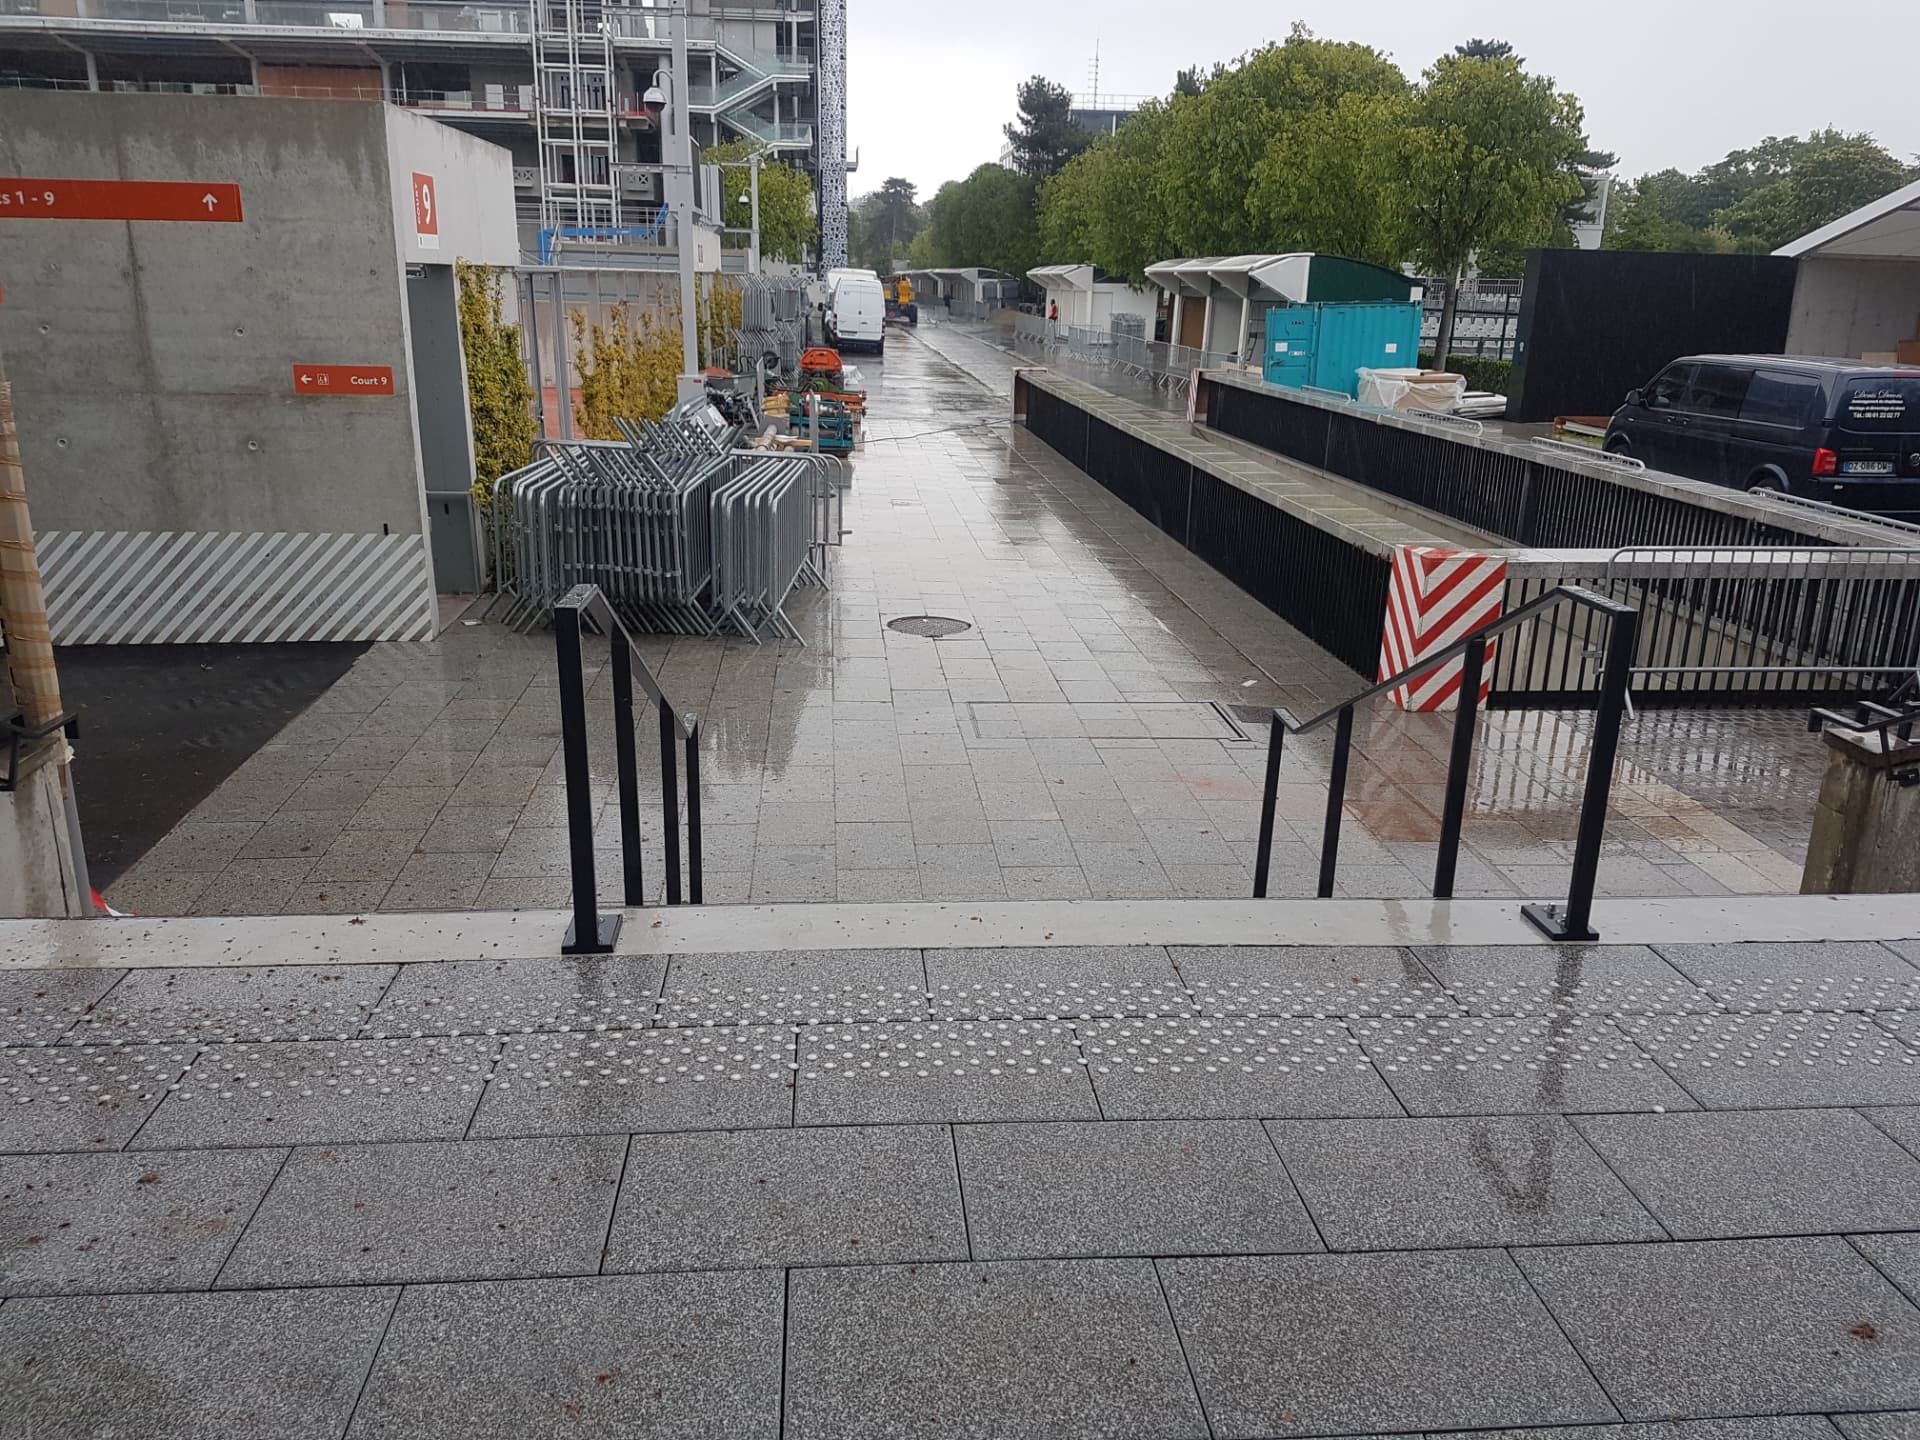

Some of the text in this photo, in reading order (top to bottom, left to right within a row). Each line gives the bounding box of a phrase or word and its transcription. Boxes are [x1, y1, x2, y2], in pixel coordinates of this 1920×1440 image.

[15, 190, 25, 205] 1
[43, 191, 55, 206] 9
[422, 183, 431, 225] 9
[350, 376, 388, 385] Court 9
